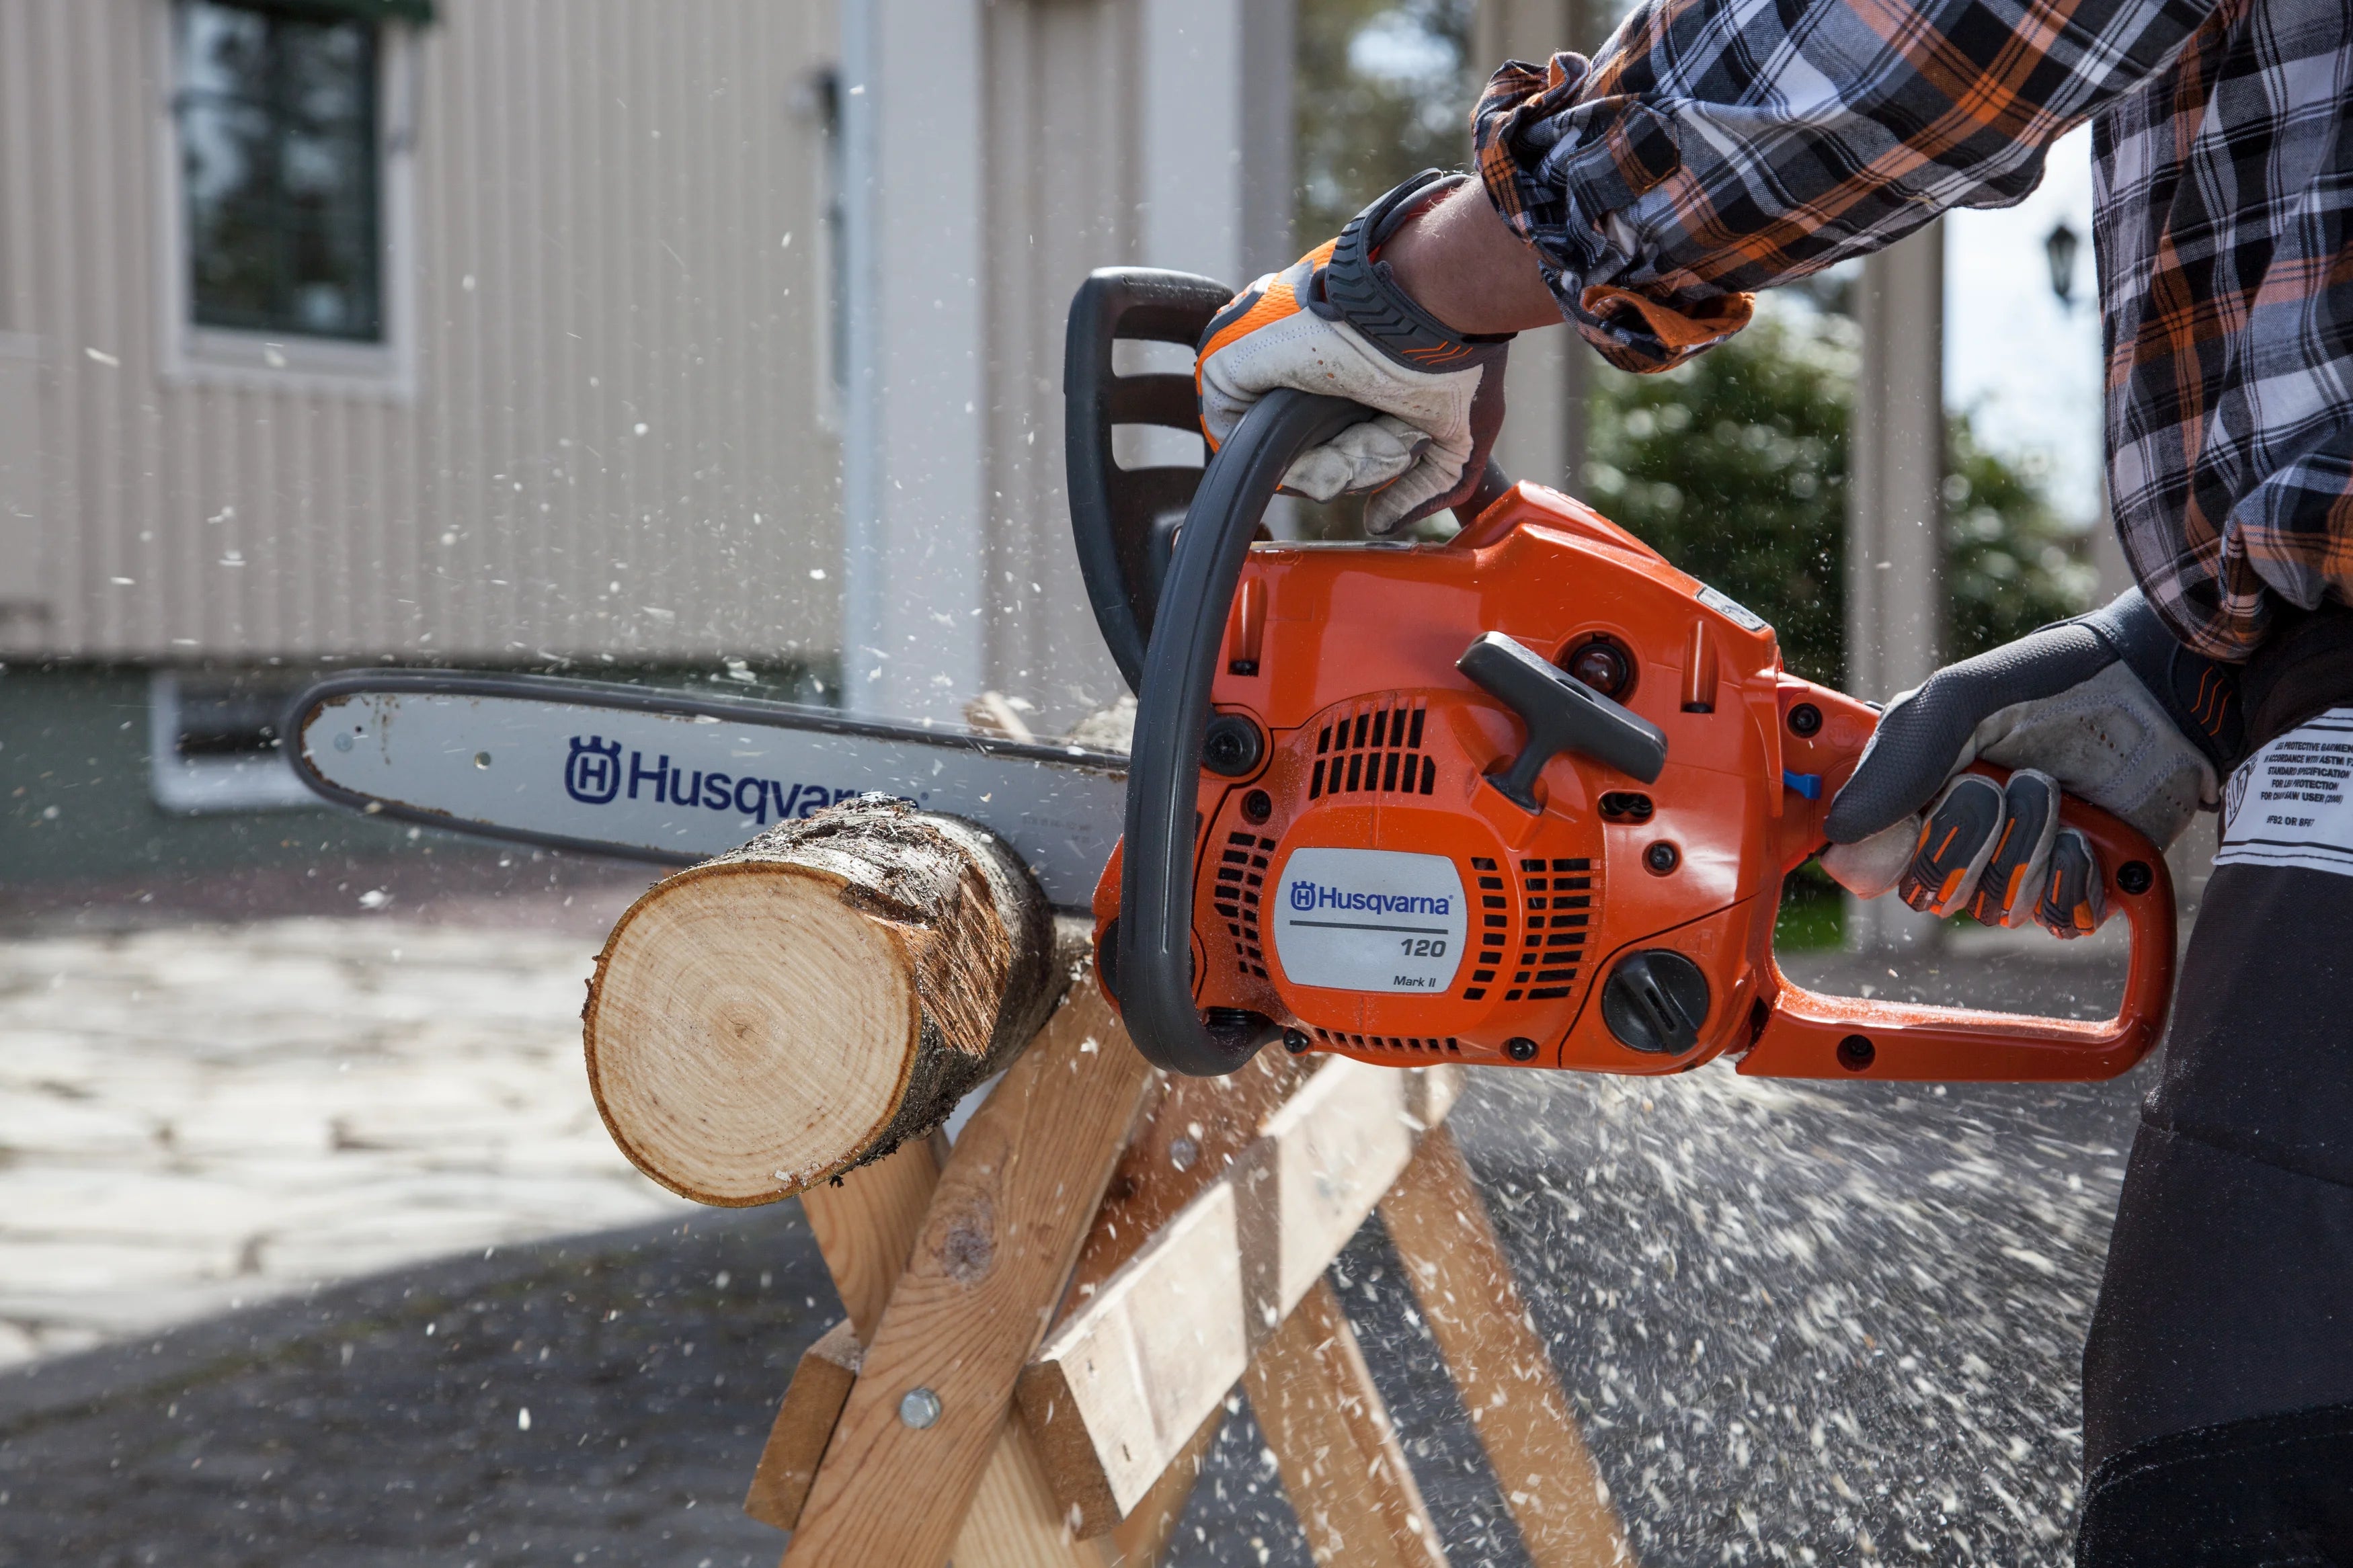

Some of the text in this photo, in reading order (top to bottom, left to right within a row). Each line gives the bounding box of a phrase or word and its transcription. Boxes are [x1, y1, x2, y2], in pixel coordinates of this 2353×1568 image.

[2284, 741, 2321, 751] PROTECTIVE
[2268, 754, 2305, 764] ACCORDANCE
[2305, 755, 2320, 764] WITH
[2319, 755, 2345, 766] ASTM
[2268, 766, 2352, 779] STANDARD SPECIFICATION
[627, 751, 920, 825] Husqvar
[2272, 779, 2284, 788] FOR
[2292, 779, 2340, 790] PROTECTION
[2261, 792, 2273, 800] FOR
[2302, 792, 2325, 802] USER
[2285, 816, 2298, 826] OR
[1318, 886, 1449, 915] Husqvarna
[1400, 938, 1447, 958] 120
[1393, 975, 1436, 987] Mark II
